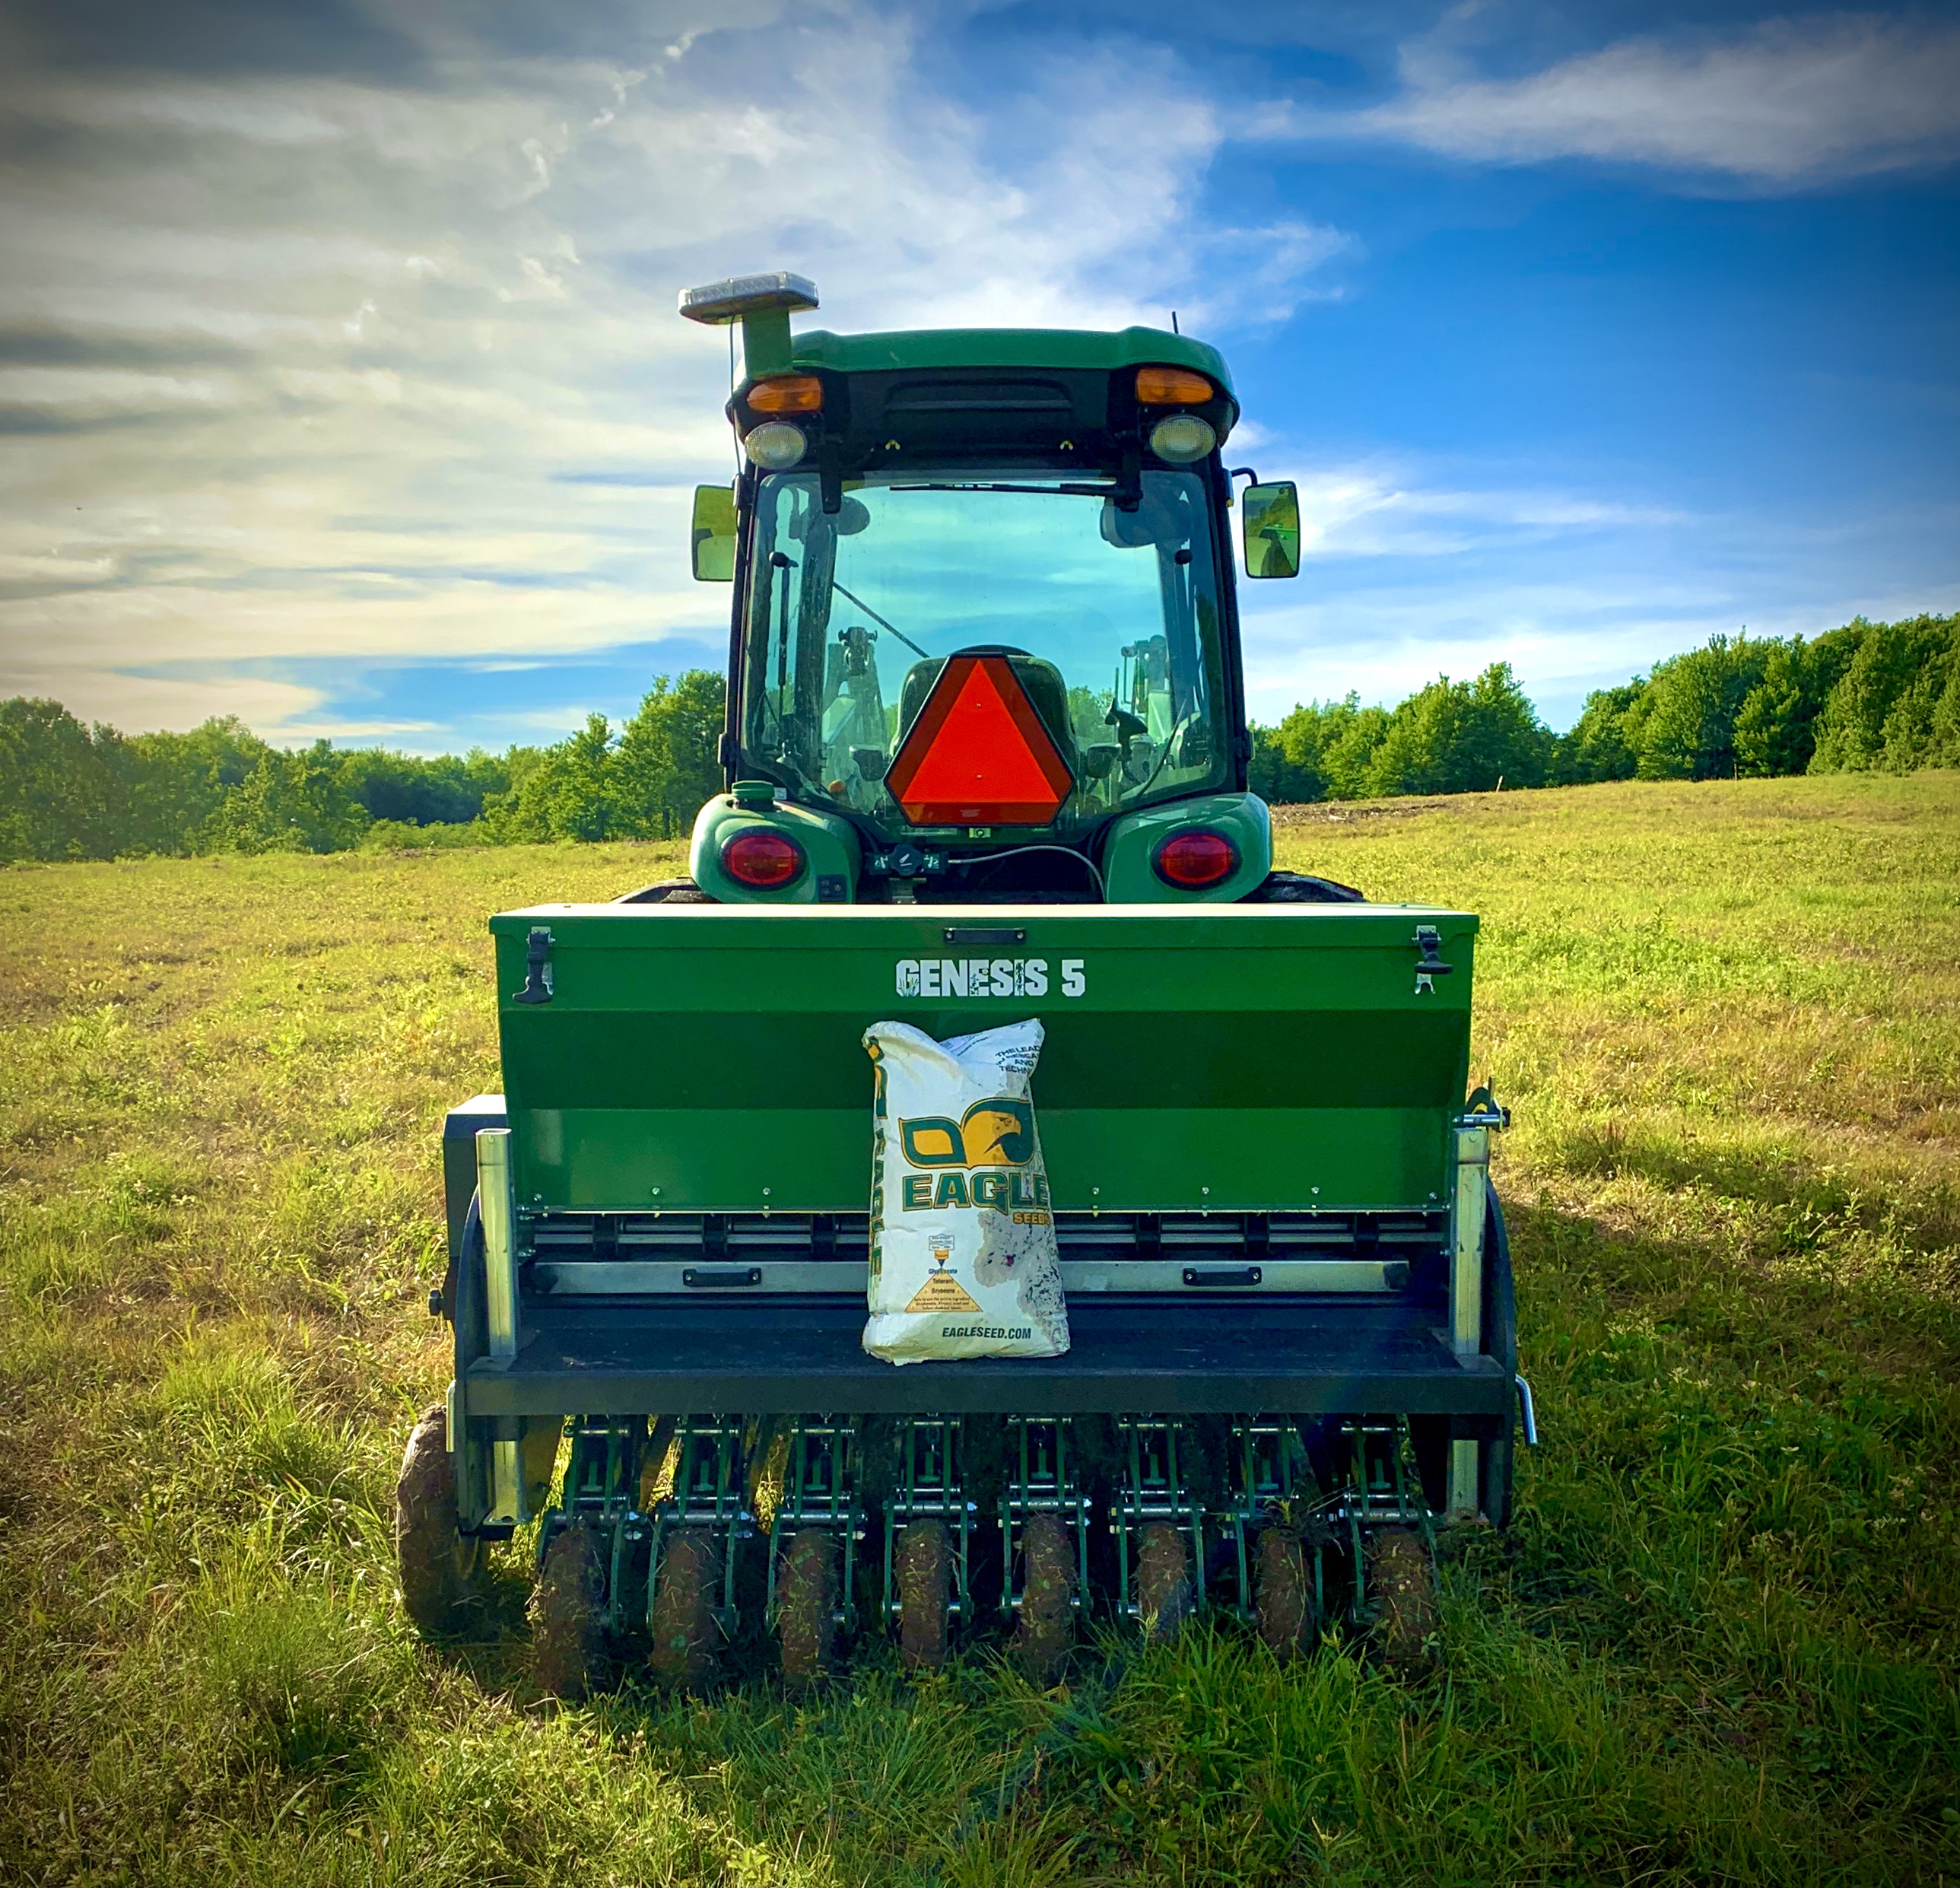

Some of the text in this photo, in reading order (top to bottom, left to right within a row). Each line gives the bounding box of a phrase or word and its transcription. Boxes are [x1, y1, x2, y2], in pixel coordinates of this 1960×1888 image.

[895, 958, 1086, 997] GENESIS 5
[995, 1048, 1015, 1057] THE
[902, 1172, 1050, 1216] EAGLE
[942, 1327, 1031, 1339] EAGLESEED.COM
